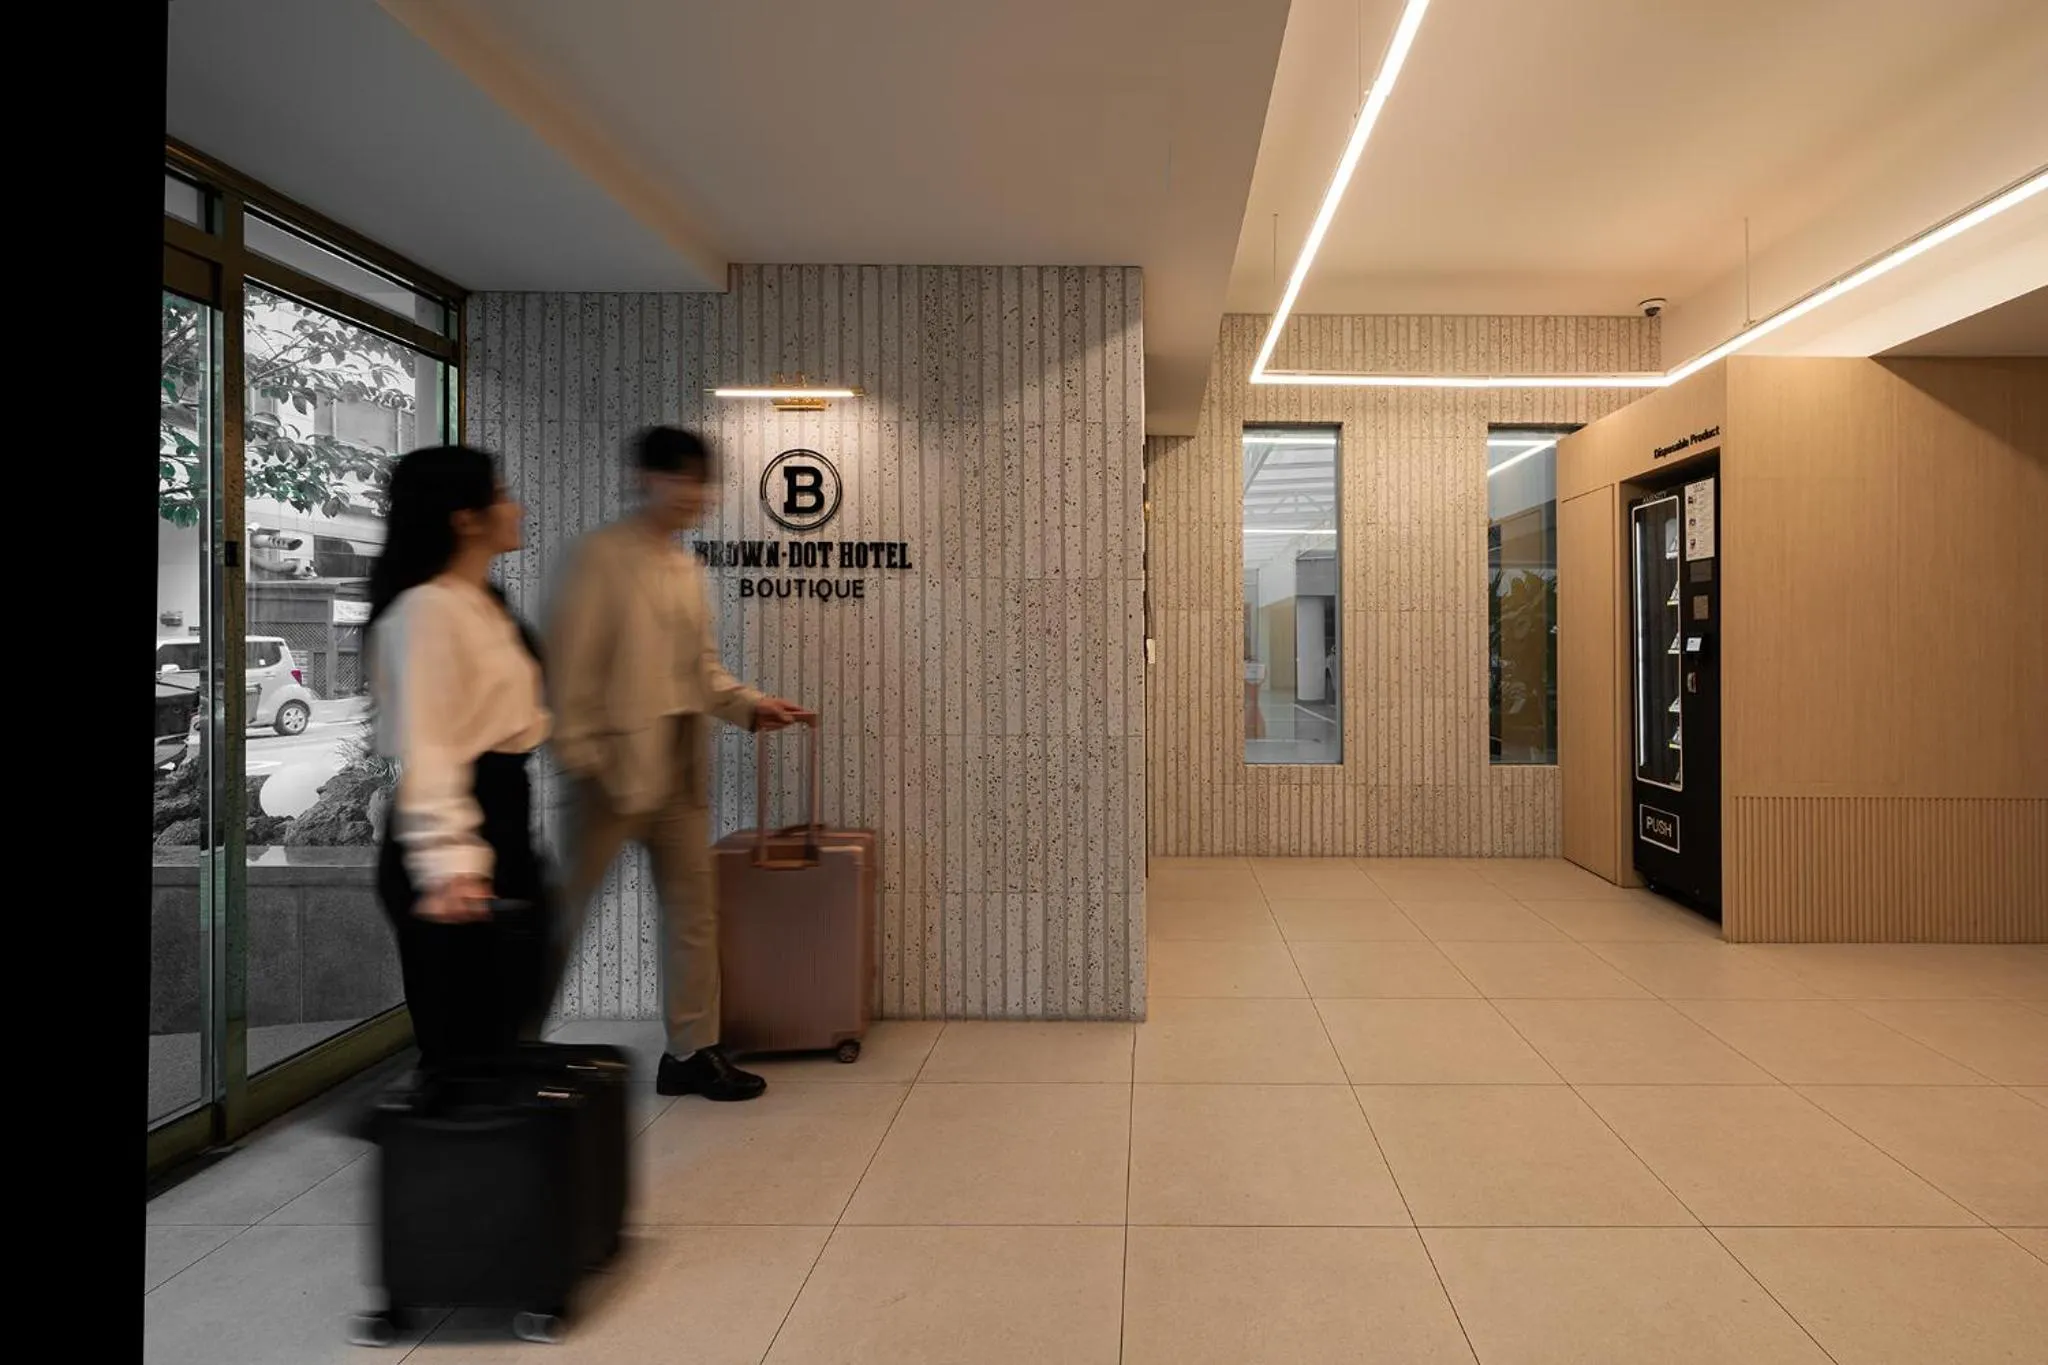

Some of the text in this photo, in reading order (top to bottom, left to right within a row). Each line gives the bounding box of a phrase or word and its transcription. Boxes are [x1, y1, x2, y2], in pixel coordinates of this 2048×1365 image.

[1690, 425, 1720, 445] Product
[783, 466, 825, 514] B
[839, 542, 912, 569] HOTEL
[740, 578, 865, 602] BOUTIQUE
[1646, 815, 1672, 838] PUSH
